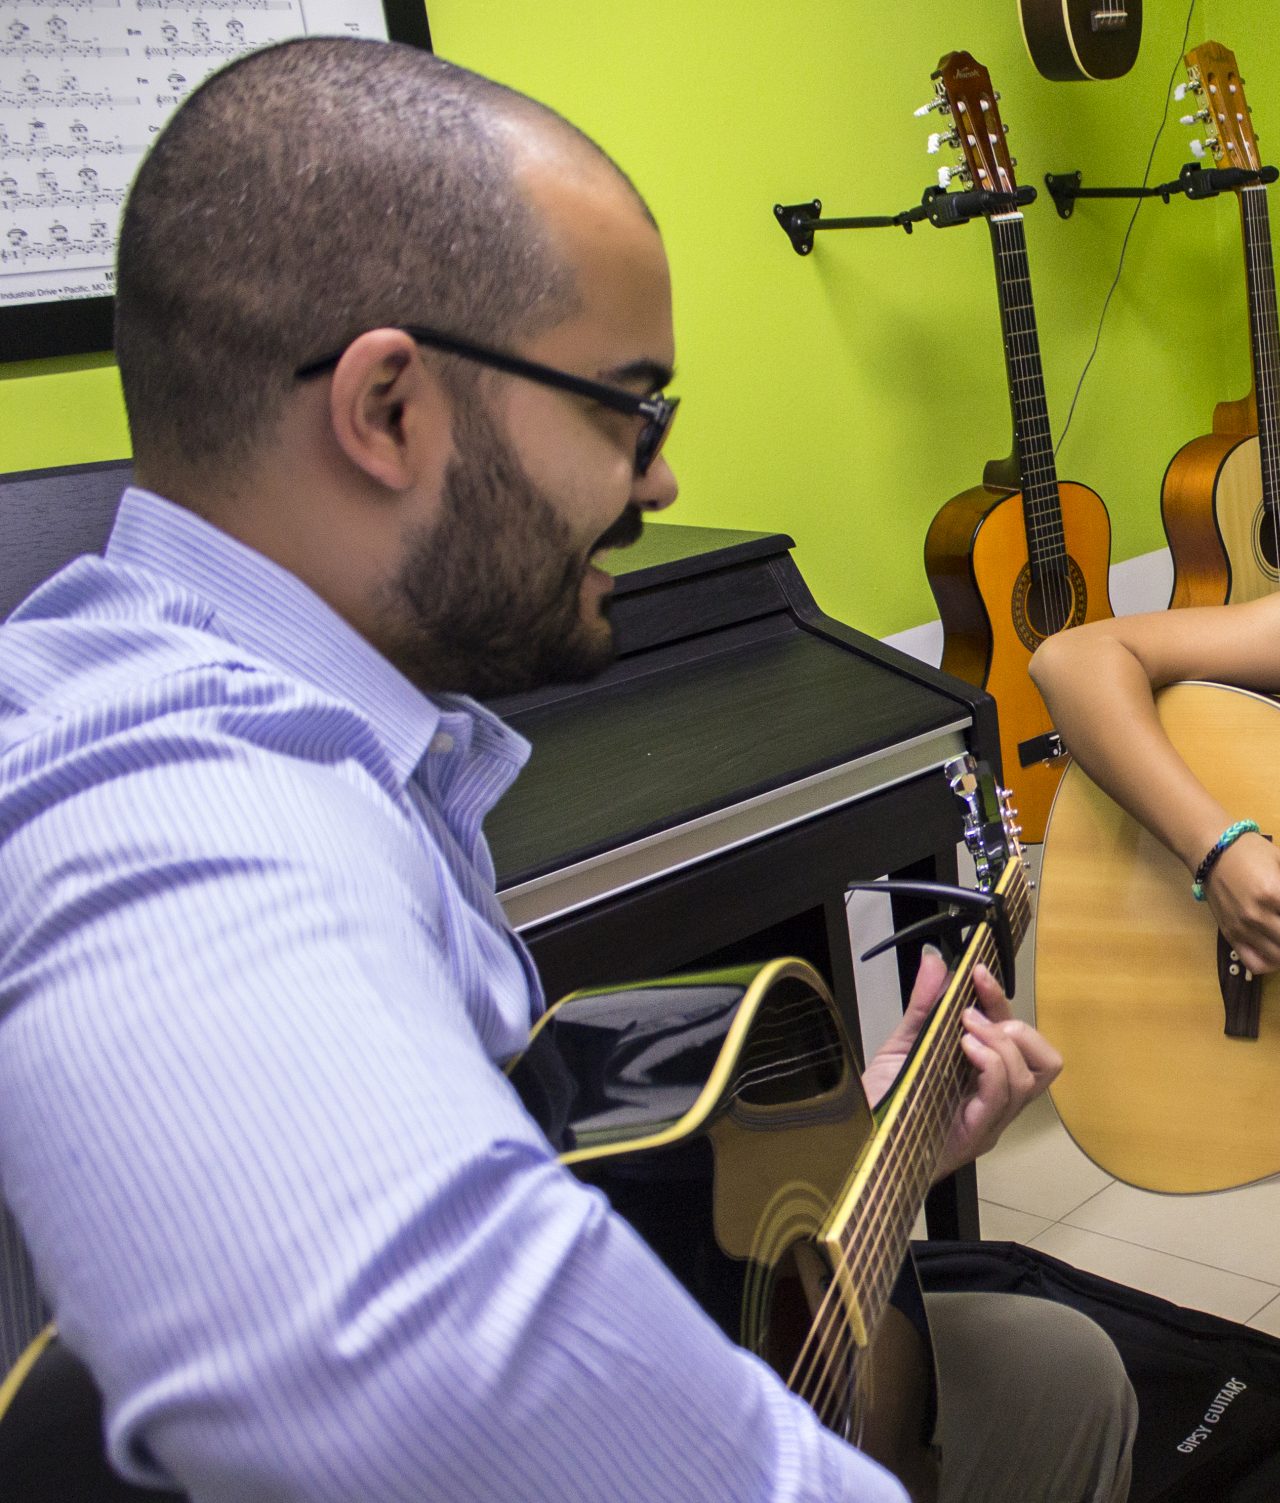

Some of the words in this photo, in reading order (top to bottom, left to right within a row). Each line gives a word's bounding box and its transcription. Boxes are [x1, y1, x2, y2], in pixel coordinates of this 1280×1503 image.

[0, 290, 36, 299] Industrial
[37, 288, 58, 297] Drive
[1176, 1424, 1213, 1453] GIPSY
[1203, 1377, 1247, 1424] GUITARS
